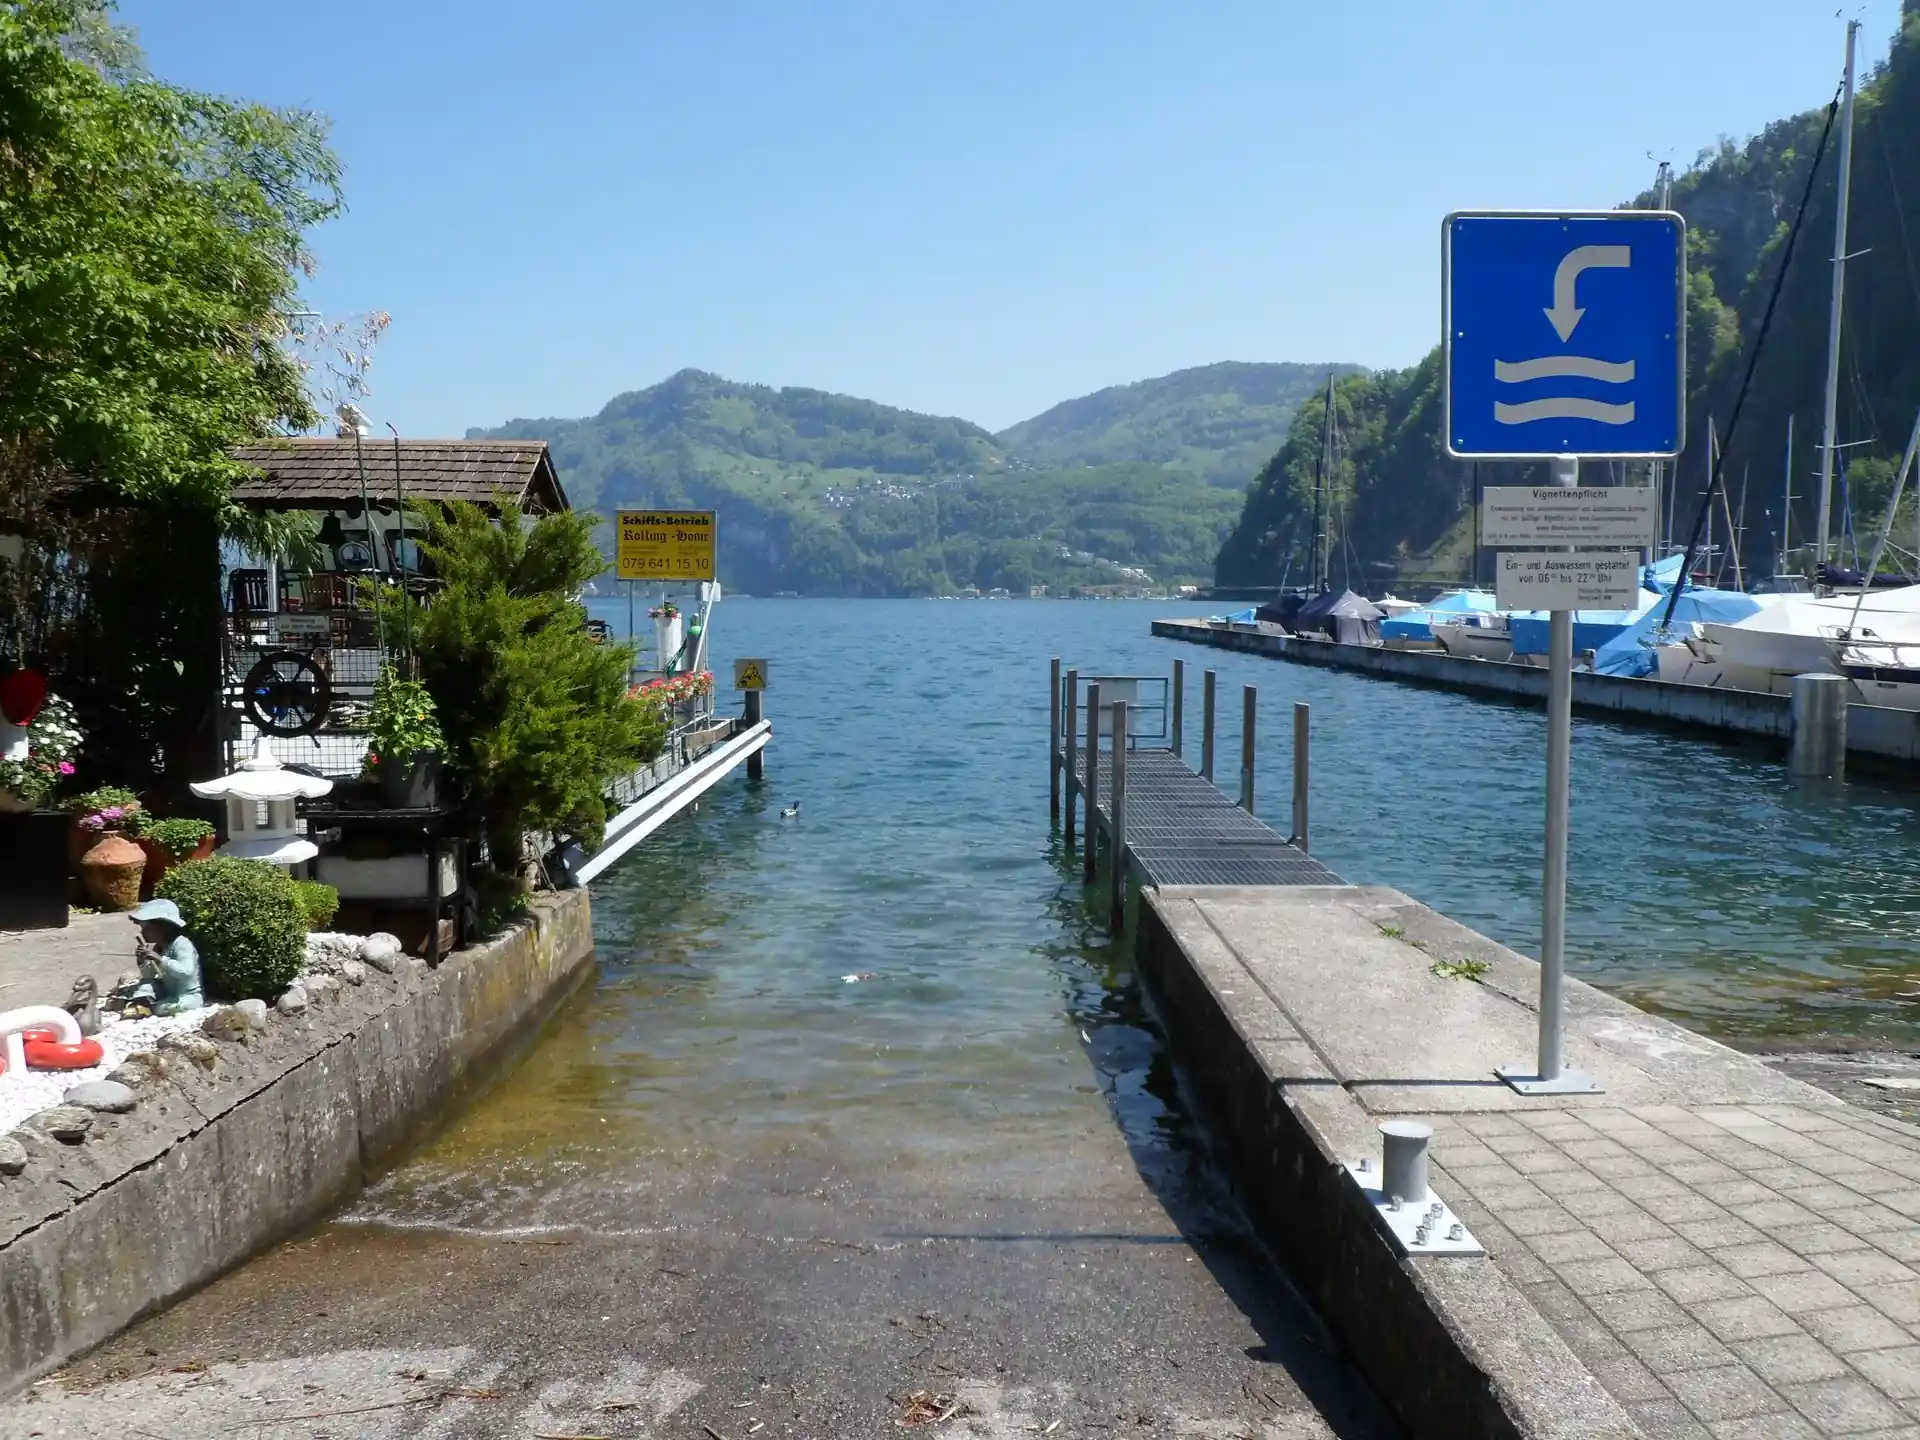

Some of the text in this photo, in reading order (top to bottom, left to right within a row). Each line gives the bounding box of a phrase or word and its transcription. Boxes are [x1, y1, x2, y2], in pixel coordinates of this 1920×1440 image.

[1532, 489, 1608, 501] Vignettenpflicht
[622, 515, 709, 525] Schiffs-Betrieb
[622, 557, 709, 569] 079 641 15 10
[1505, 561, 1630, 571] Ein- und Auswassern gestattet
[1519, 575, 1534, 584] von
[1560, 573, 1573, 584] bis
[1598, 573, 1613, 584] Uhr
